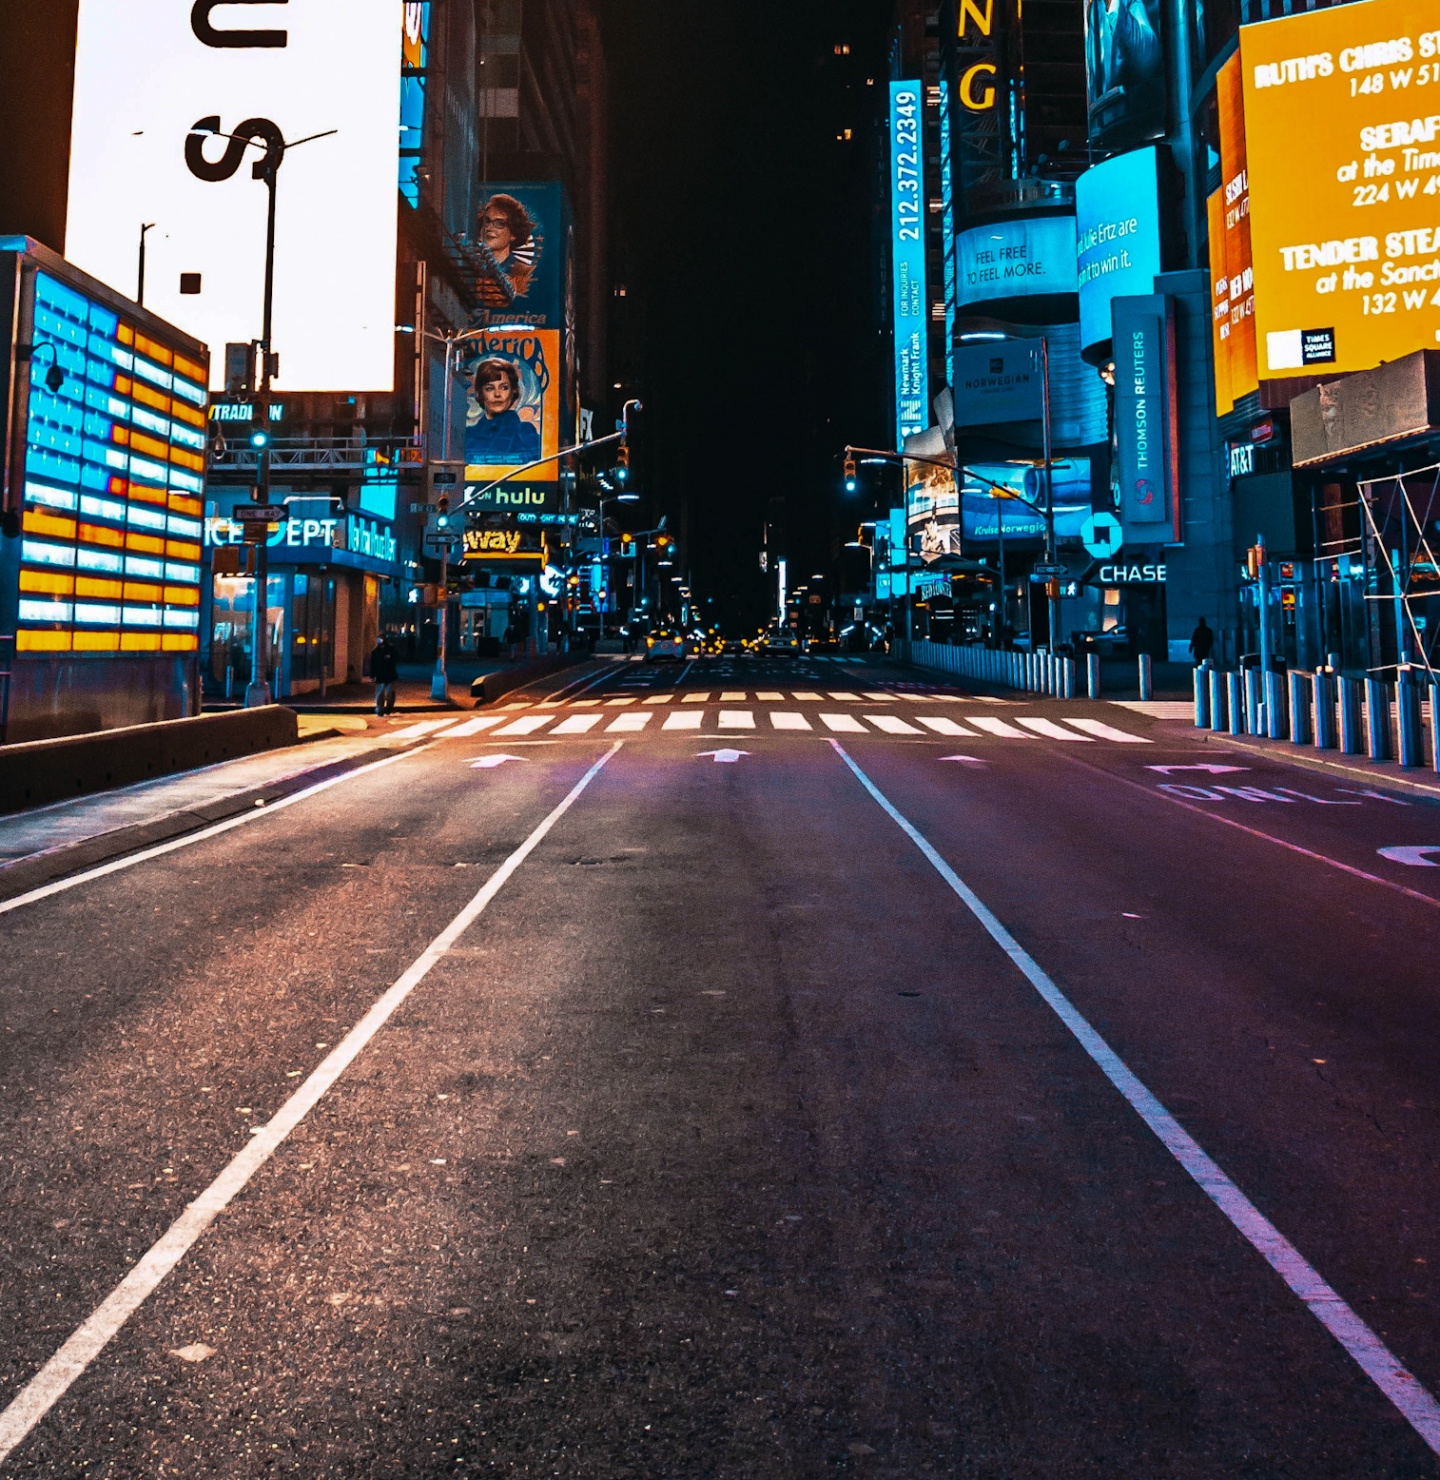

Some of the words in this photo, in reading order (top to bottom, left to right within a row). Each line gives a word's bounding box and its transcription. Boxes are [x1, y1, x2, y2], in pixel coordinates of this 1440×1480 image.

[1350, 73, 1384, 97] 148
[1390, 67, 1413, 90] W
[896, 91, 920, 241] 212.372.2349
[1337, 160, 1358, 182] at
[1364, 153, 1395, 178] the
[1353, 183, 1390, 206] 224
[1395, 177, 1419, 200] W
[1098, 223, 1116, 243] Ertz
[1118, 218, 1137, 236] are
[976, 250, 995, 265] FEEL
[1000, 245, 1027, 259] FREE
[1101, 253, 1118, 274] win
[1120, 249, 1132, 268] it.
[1279, 236, 1379, 271] TENDER
[899, 261, 909, 300] INQUIRIES
[967, 272, 976, 286] TO
[979, 268, 999, 283] FEEL
[1003, 261, 1046, 278] MORE.
[1316, 272, 1337, 294] at
[1342, 265, 1374, 290] the
[900, 301, 909, 317] FOR
[911, 280, 920, 316] CONTACT
[1362, 292, 1397, 315] 132
[1402, 289, 1427, 310] W
[910, 331, 920, 360] Frank
[1304, 342, 1332, 352] SQUARE
[1306, 334, 1330, 343] TIMES
[900, 348, 910, 395] Newmark
[911, 361, 923, 395] Knight
[1133, 332, 1145, 395] REUTERS
[965, 374, 1030, 389] NORWEGIAN
[1136, 399, 1148, 470] THOMSON
[1231, 444, 1254, 477] AT&T
[495, 487, 545, 504] hulu
[1099, 564, 1167, 583] CHASE
[1156, 783, 1412, 806] ONLY
